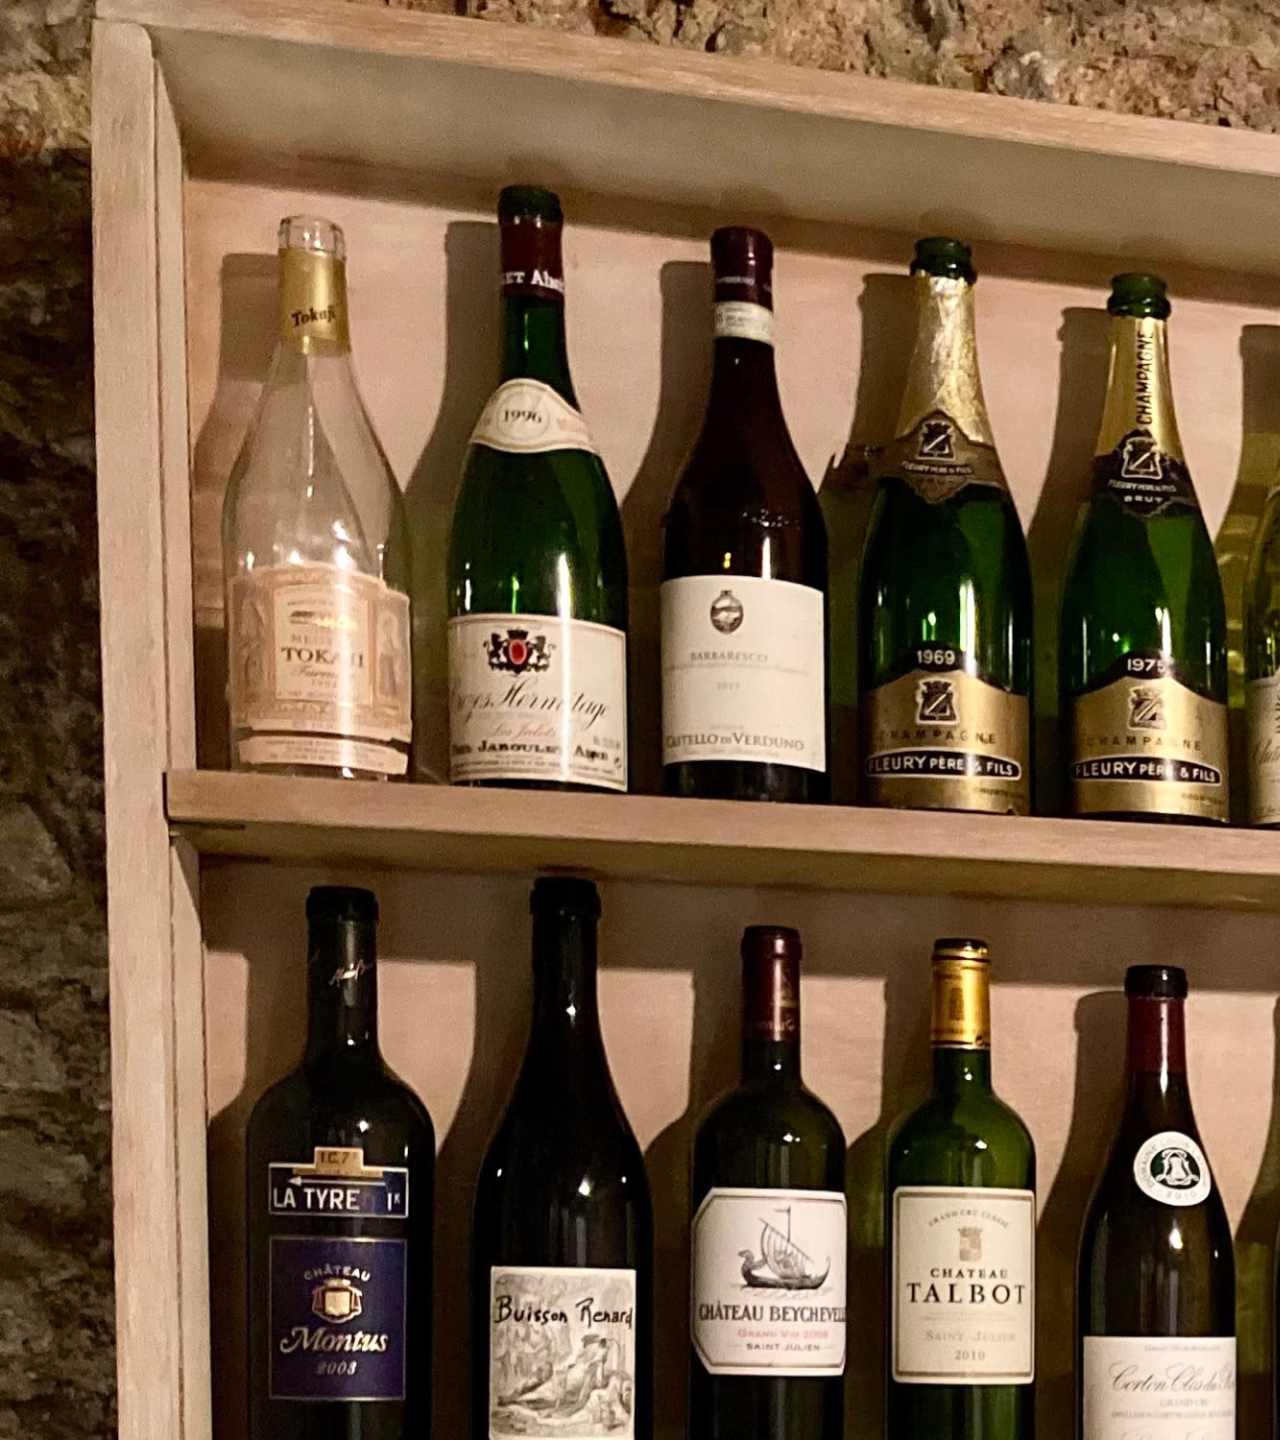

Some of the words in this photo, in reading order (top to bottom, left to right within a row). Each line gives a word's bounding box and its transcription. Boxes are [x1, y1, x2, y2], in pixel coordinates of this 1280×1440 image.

[292, 306, 336, 330] Tokaji
[1137, 330, 1154, 425] CHAMPAGNE
[502, 408, 543, 423] 1996
[1123, 495, 1164, 504] BRUT
[281, 646, 364, 668] TOKAI
[690, 652, 768, 662] BARBARESCO
[917, 650, 956, 665] 1969
[665, 735, 718, 750] CASTELLO
[734, 733, 805, 751] VERDUNO
[1087, 734, 1202, 752] CHAMPANE
[868, 756, 927, 773] FLEURY
[929, 757, 964, 772] PÈRE
[986, 759, 1013, 776] FILS
[1075, 761, 1136, 778] FLEURY
[1192, 768, 1217, 783] FILS
[273, 1188, 296, 1209] LA
[304, 1188, 360, 1210] TYRE
[304, 1262, 371, 1284] CHÂTEAU
[930, 1268, 1009, 1280] CHATEAU
[907, 1282, 1026, 1305] TALBOT
[494, 1296, 568, 1325] Buisson
[575, 1296, 633, 1326] Renard
[700, 1300, 764, 1323] CHÂTEAU
[280, 1326, 388, 1354] Montus
[954, 1350, 986, 1361] 2010
[1109, 1361, 1168, 1393] Corton
